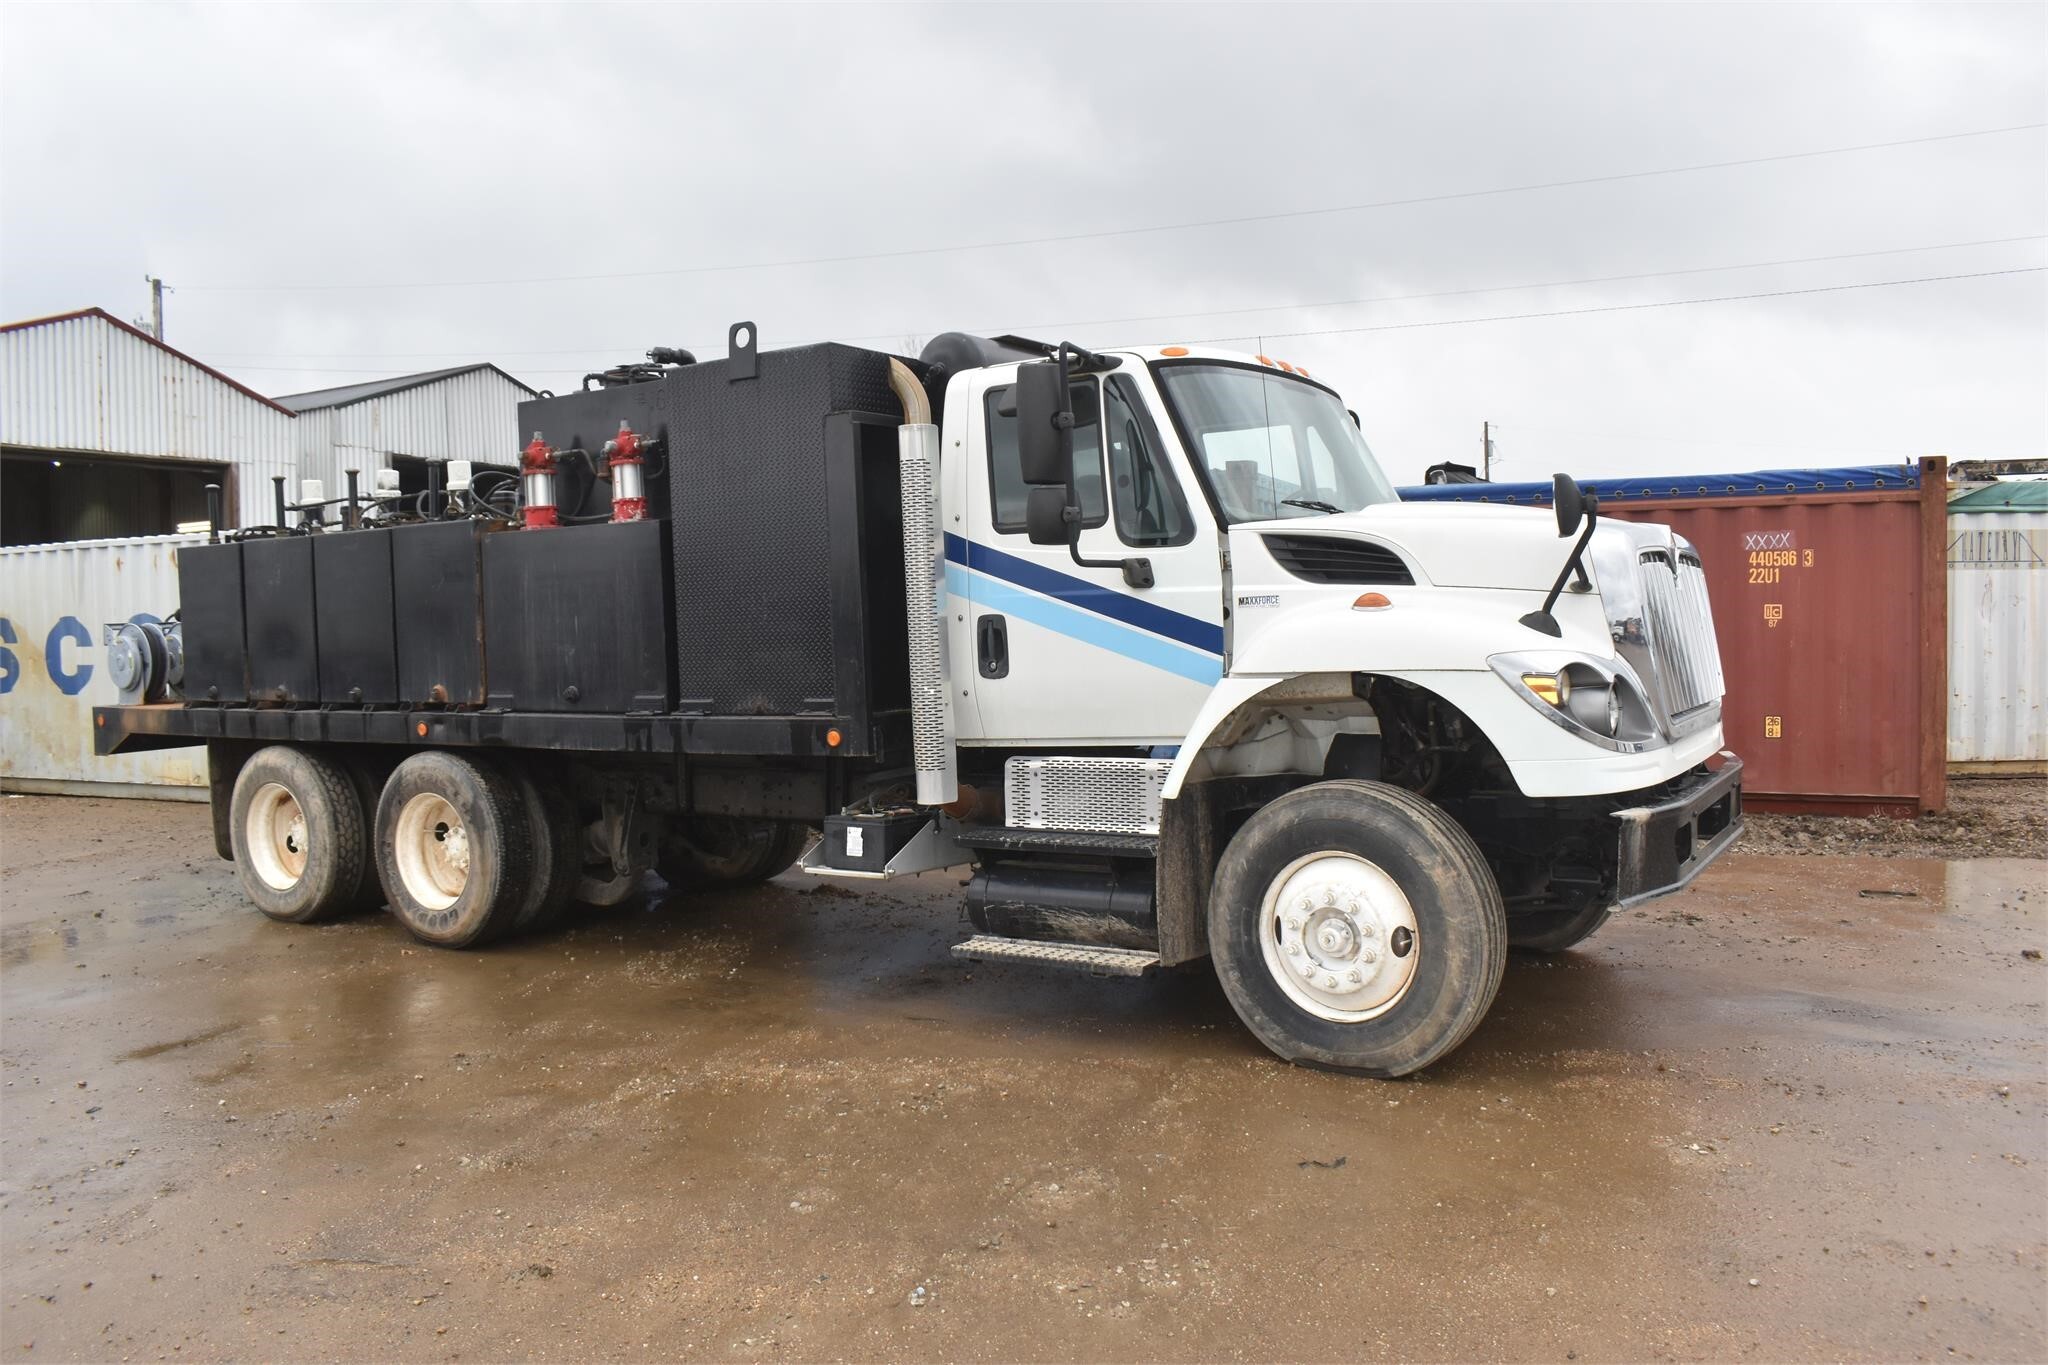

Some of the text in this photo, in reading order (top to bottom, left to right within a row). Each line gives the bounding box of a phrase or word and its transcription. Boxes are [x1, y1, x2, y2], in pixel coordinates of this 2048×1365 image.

[1745, 532, 1790, 549] XXXX
[1748, 550, 1813, 567] 440586 3
[1748, 568, 1780, 583] 22U1
[1238, 595, 1280, 605] MAXXFORCE
[1768, 619, 1778, 628] 87
